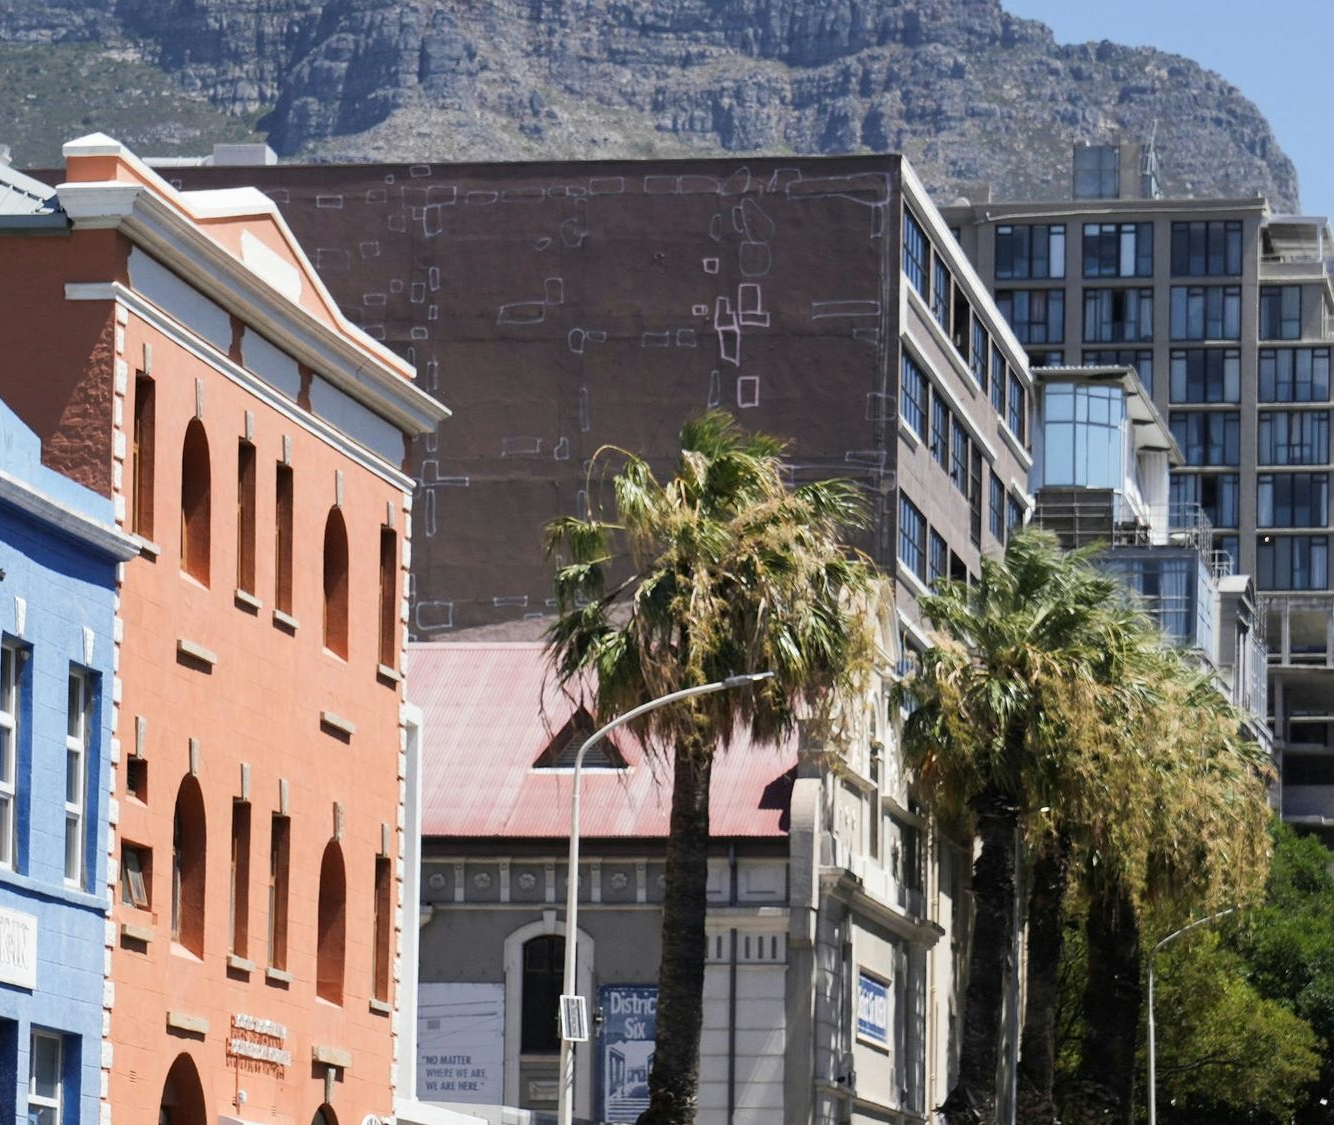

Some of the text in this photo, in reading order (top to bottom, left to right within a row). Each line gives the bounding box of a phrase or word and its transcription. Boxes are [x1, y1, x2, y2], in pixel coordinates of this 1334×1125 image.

[611, 991, 657, 1014] Distric
[624, 1017, 646, 1039] Six
[440, 1056, 471, 1065] MATTER
[426, 1069, 453, 1078] WHERE
[456, 1069, 468, 1078] WE
[426, 1081, 438, 1090] WE
[441, 1081, 454, 1090] ARE
